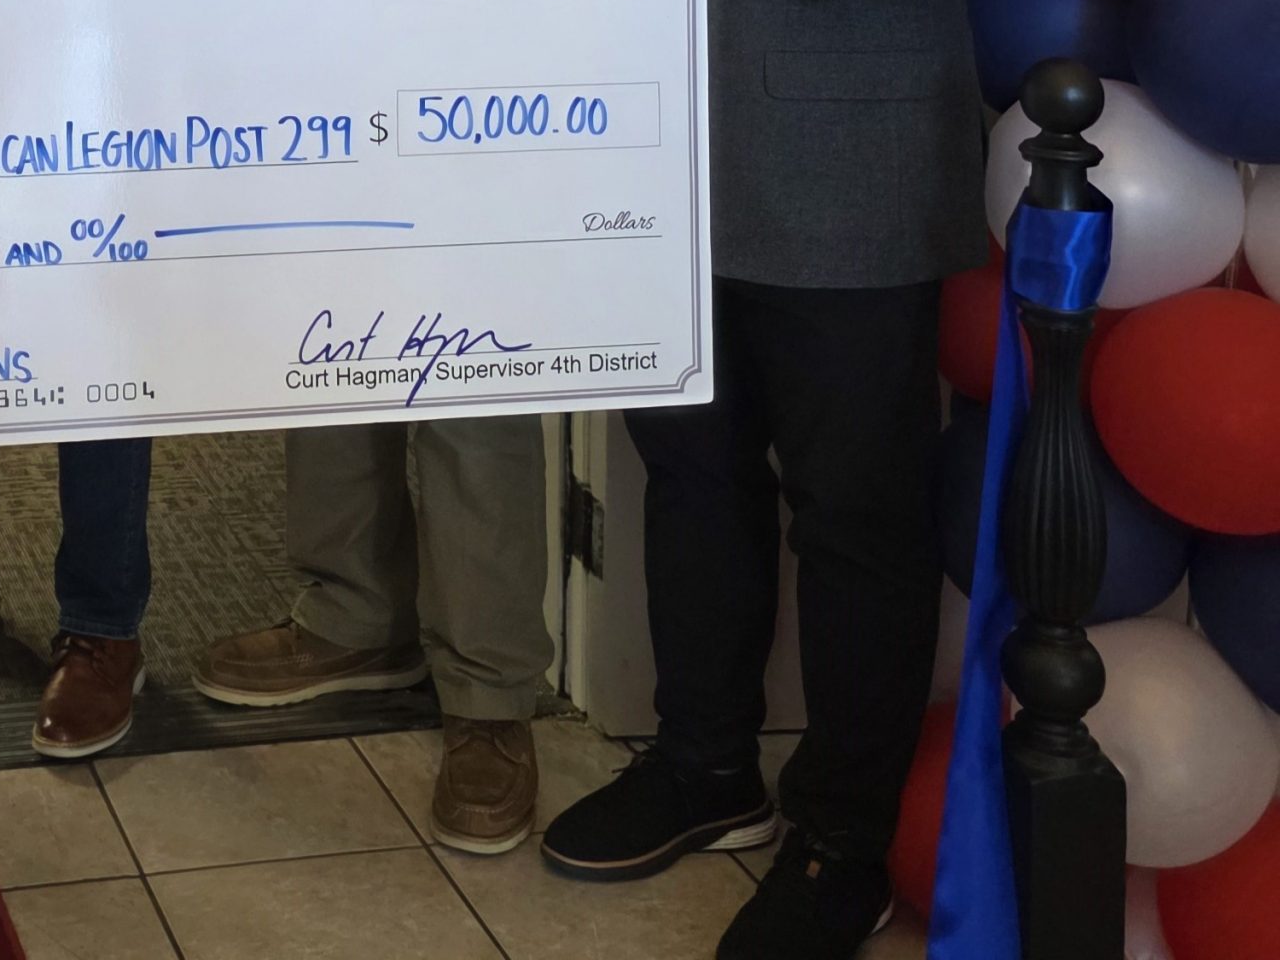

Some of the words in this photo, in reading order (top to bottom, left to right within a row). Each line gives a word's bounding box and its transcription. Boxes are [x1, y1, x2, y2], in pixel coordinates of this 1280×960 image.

[369, 110, 389, 147] $
[417, 93, 609, 145] 50,000.00
[66, 120, 177, 172] LEGION
[186, 115, 269, 169] POST
[277, 115, 352, 162] 299
[582, 210, 657, 232] Dollars
[4, 242, 63, 266] AND
[285, 368, 330, 390] Curt
[435, 356, 546, 382] Supervisor
[550, 354, 582, 375] 4th
[589, 350, 658, 373] District
[86, 381, 155, 403] 0004
